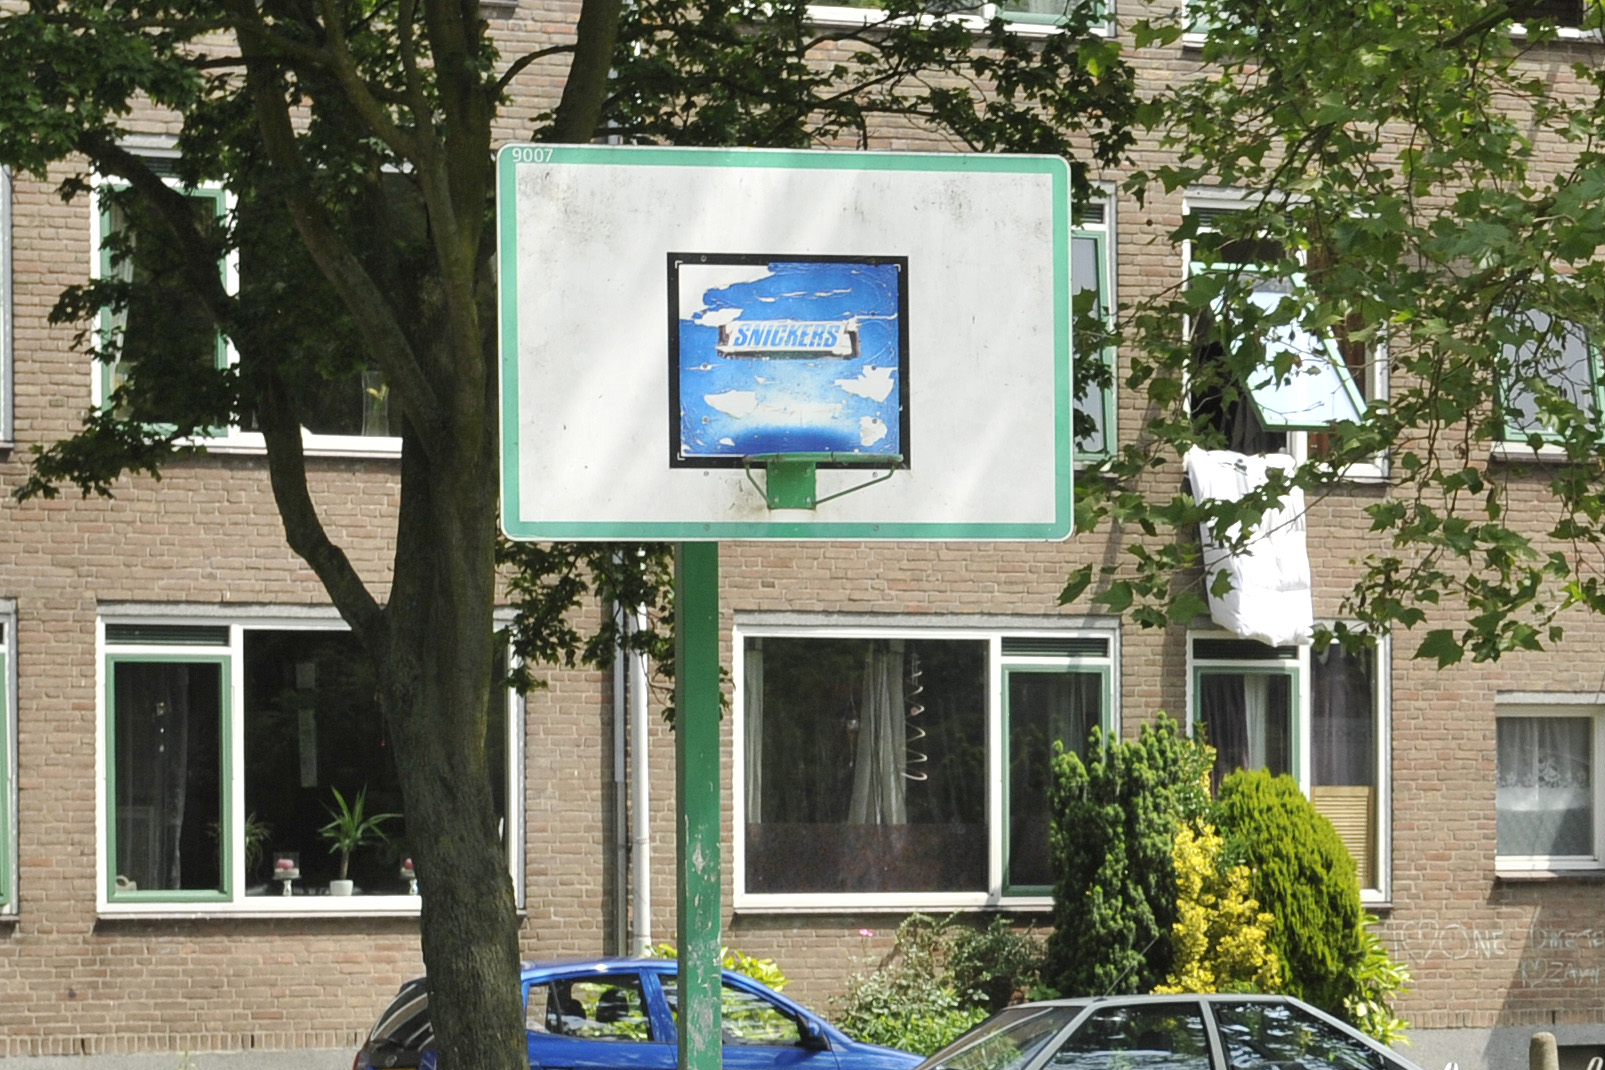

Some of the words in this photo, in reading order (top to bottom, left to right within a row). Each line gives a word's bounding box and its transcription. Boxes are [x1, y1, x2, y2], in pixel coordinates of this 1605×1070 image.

[512, 147, 554, 163] 9007
[733, 323, 841, 348] SNICKERS
[1439, 923, 1509, 960] ONE
